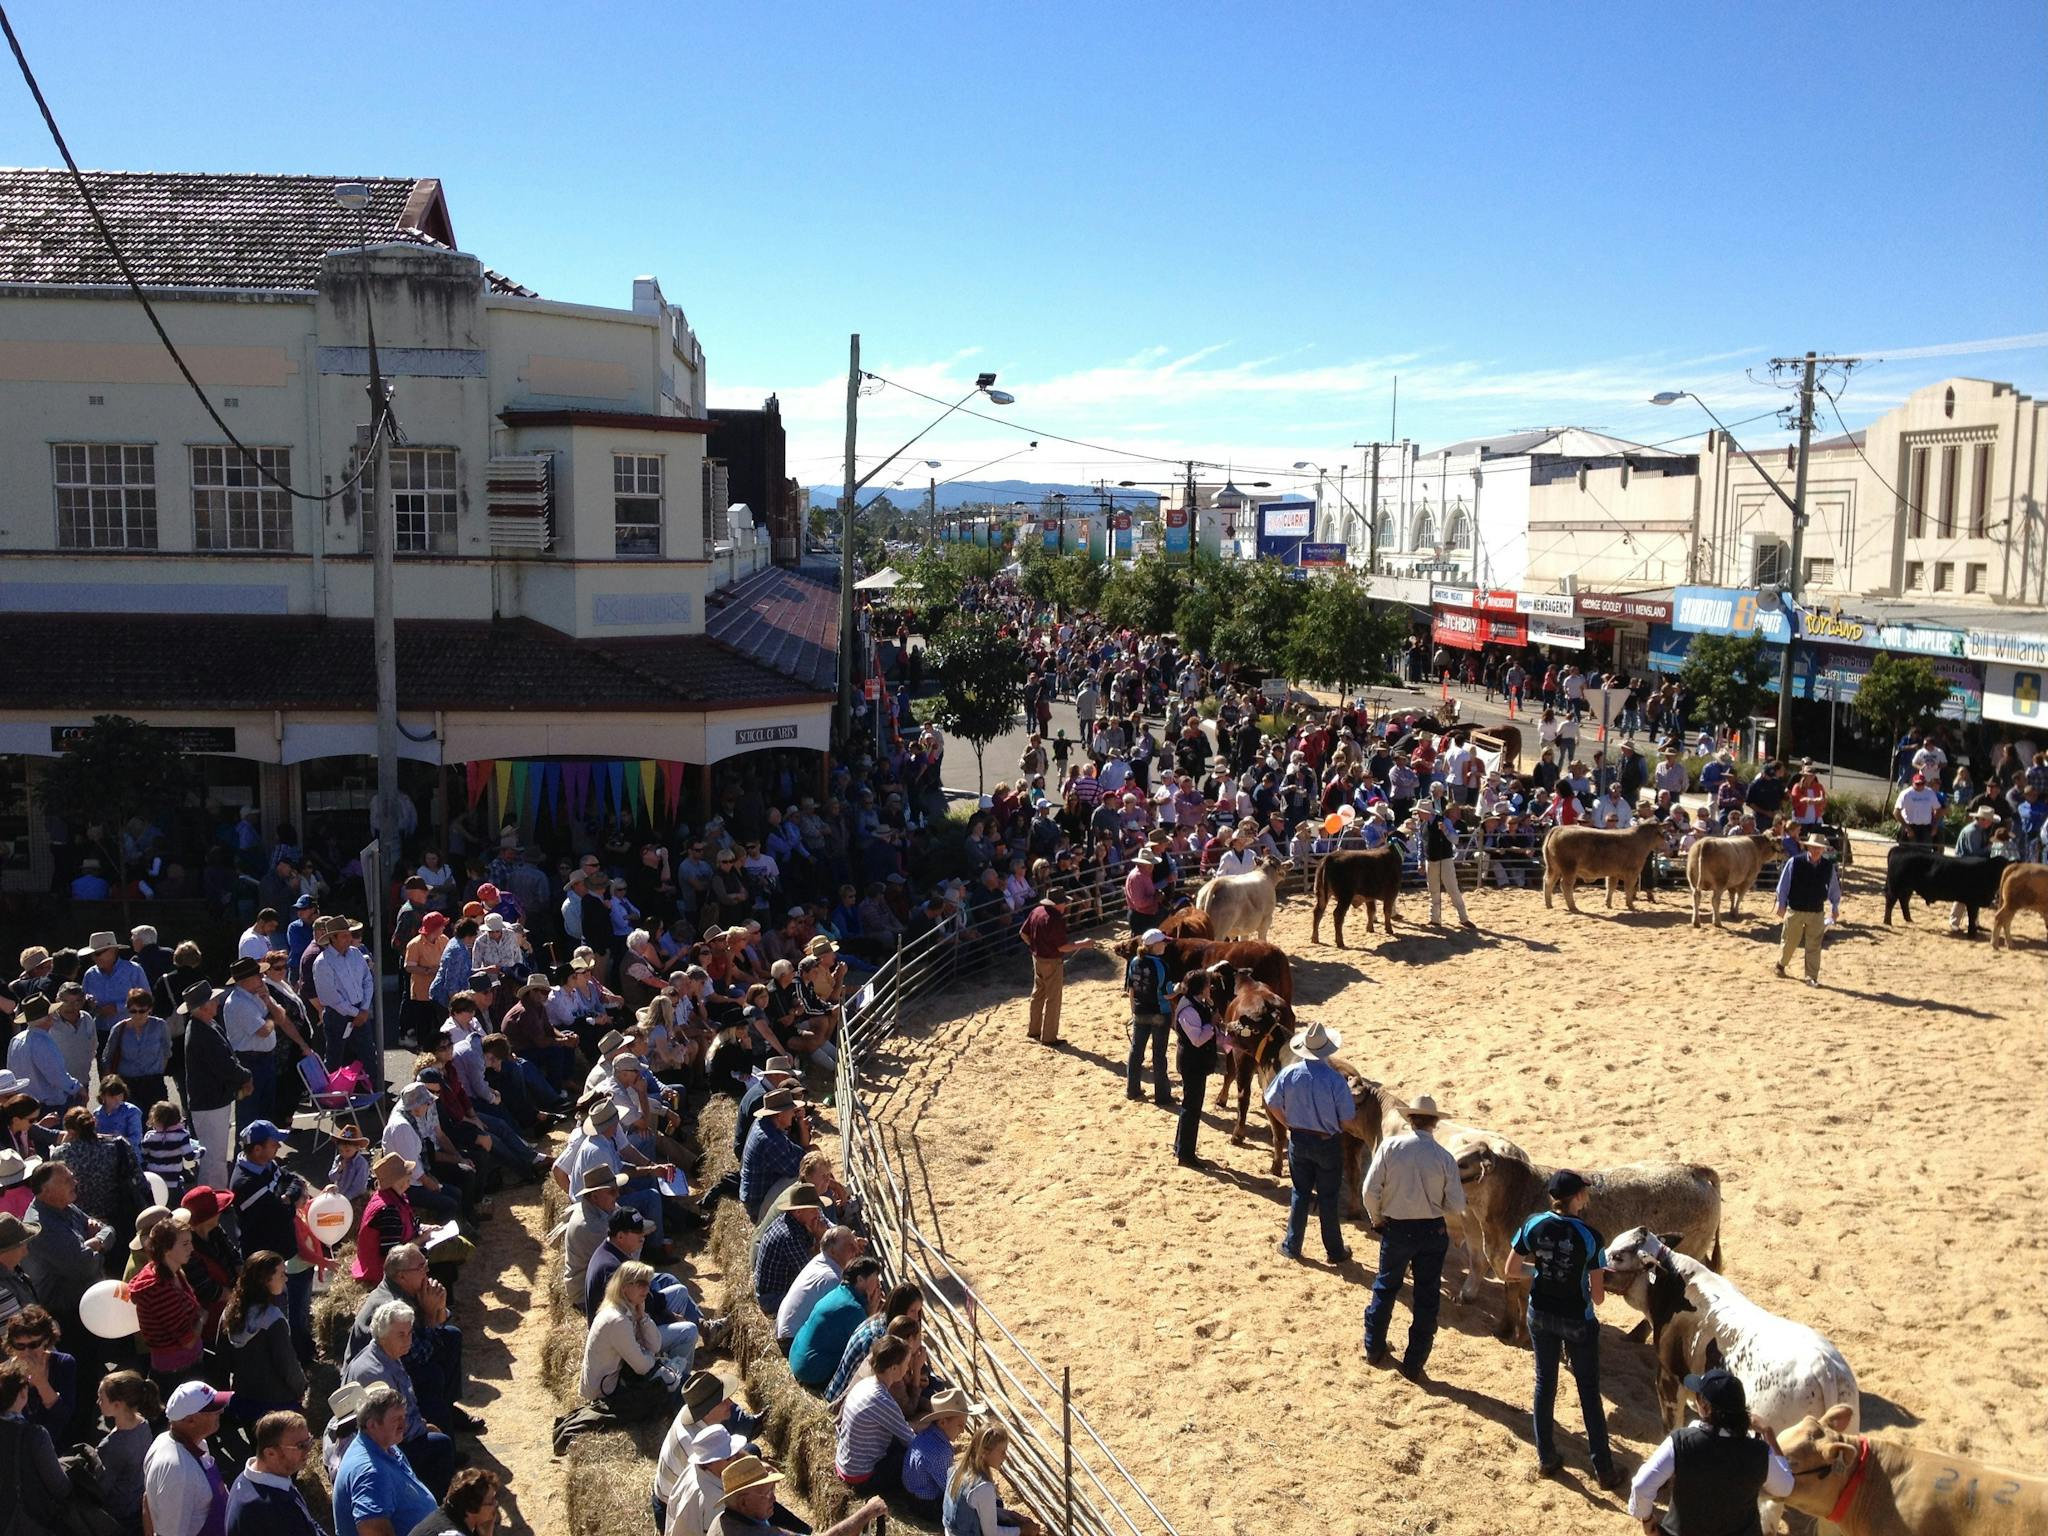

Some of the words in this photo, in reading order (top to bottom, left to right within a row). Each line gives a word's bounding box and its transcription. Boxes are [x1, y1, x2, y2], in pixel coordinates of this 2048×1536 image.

[1534, 599, 1572, 614] NEWSAGENCY
[1602, 600, 1623, 612] GOOLEY
[1635, 604, 1667, 617] MENSLAND
[1679, 597, 1733, 628] SUMMERLAND
[1805, 614, 1864, 641] TOYLAND
[1880, 626, 1902, 648] POOL
[1971, 631, 1989, 657] Bill
[1933, 663, 1971, 674] ualified
[740, 729, 764, 742] SCHOOL
[766, 728, 774, 740] OF
[778, 726, 795, 739] ARTS
